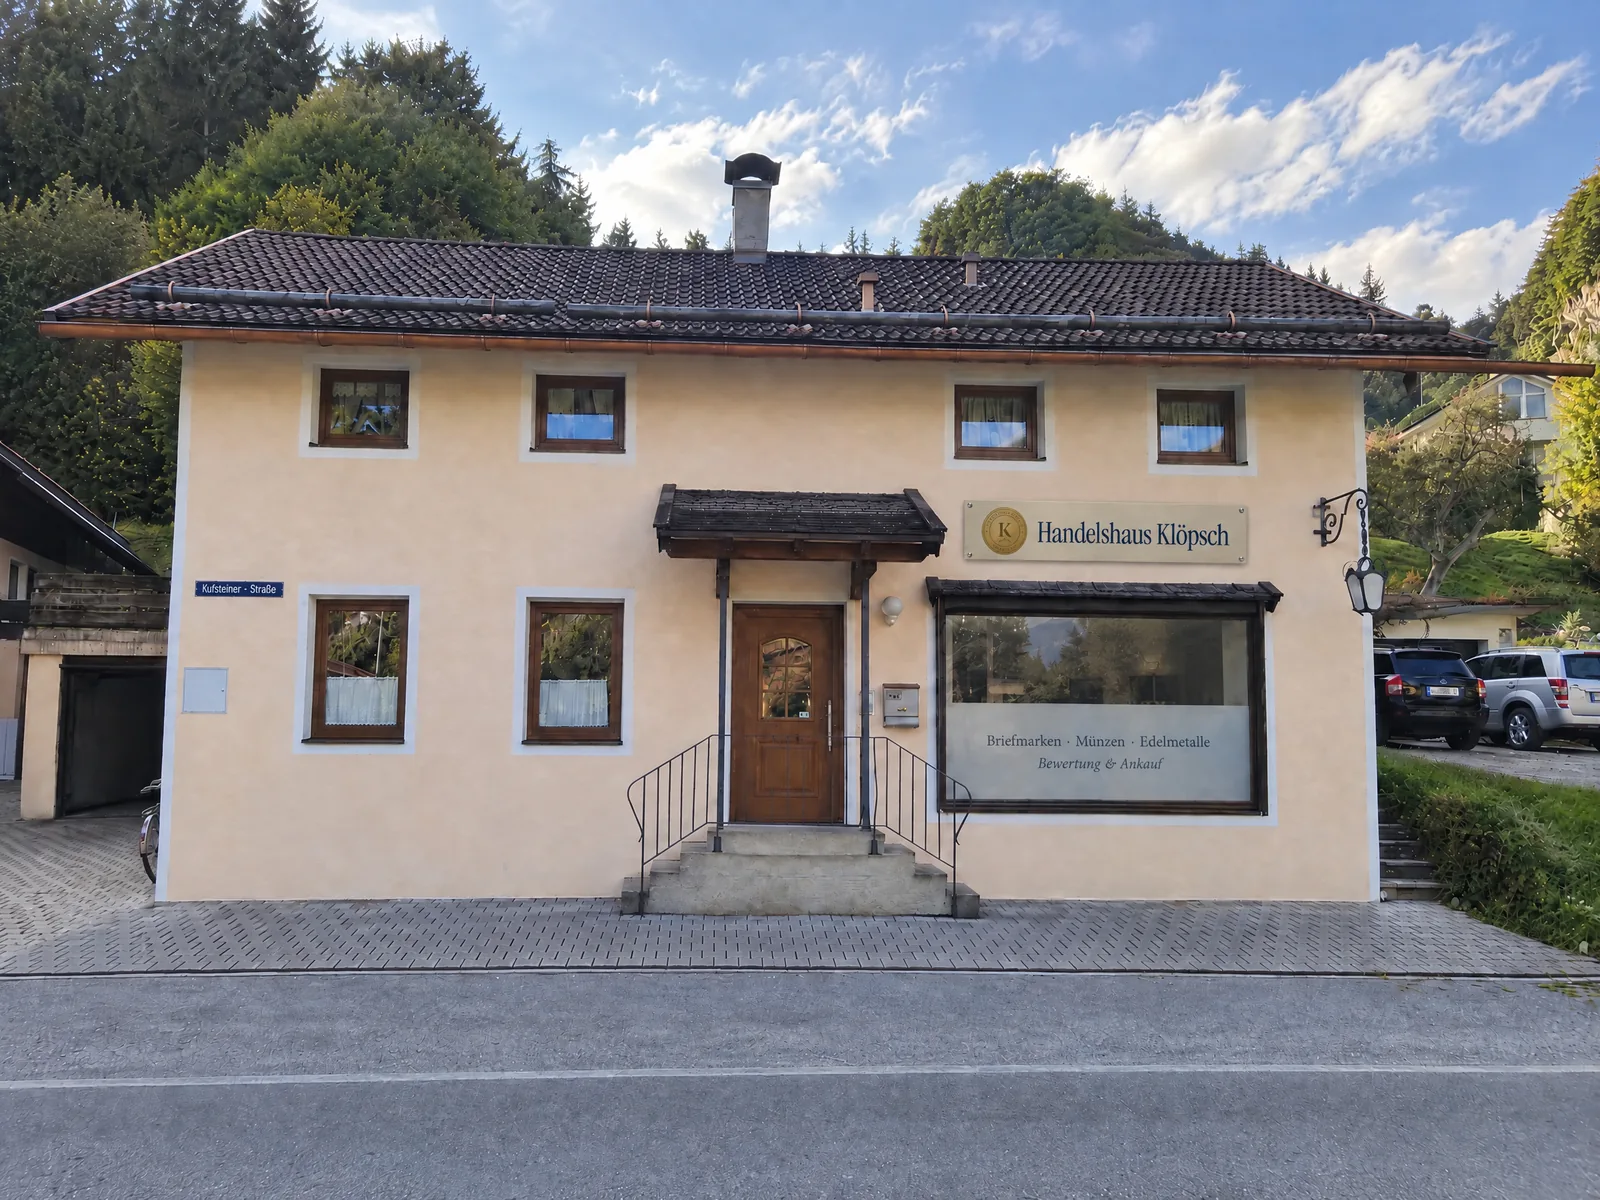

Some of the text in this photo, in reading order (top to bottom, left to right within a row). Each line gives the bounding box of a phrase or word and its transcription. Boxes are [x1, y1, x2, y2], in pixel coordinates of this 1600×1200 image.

[998, 522, 1012, 538] K
[1037, 521, 1230, 551] Handelshaus Klöpsch
[202, 583, 242, 594] Kufsteiner
[250, 584, 277, 594] Straße
[986, 734, 1062, 747] Briefmarken
[1075, 735, 1126, 747] Münzen
[1139, 735, 1211, 748] Edelmetalle
[1038, 757, 1165, 773] Bewertung & Ankauf
